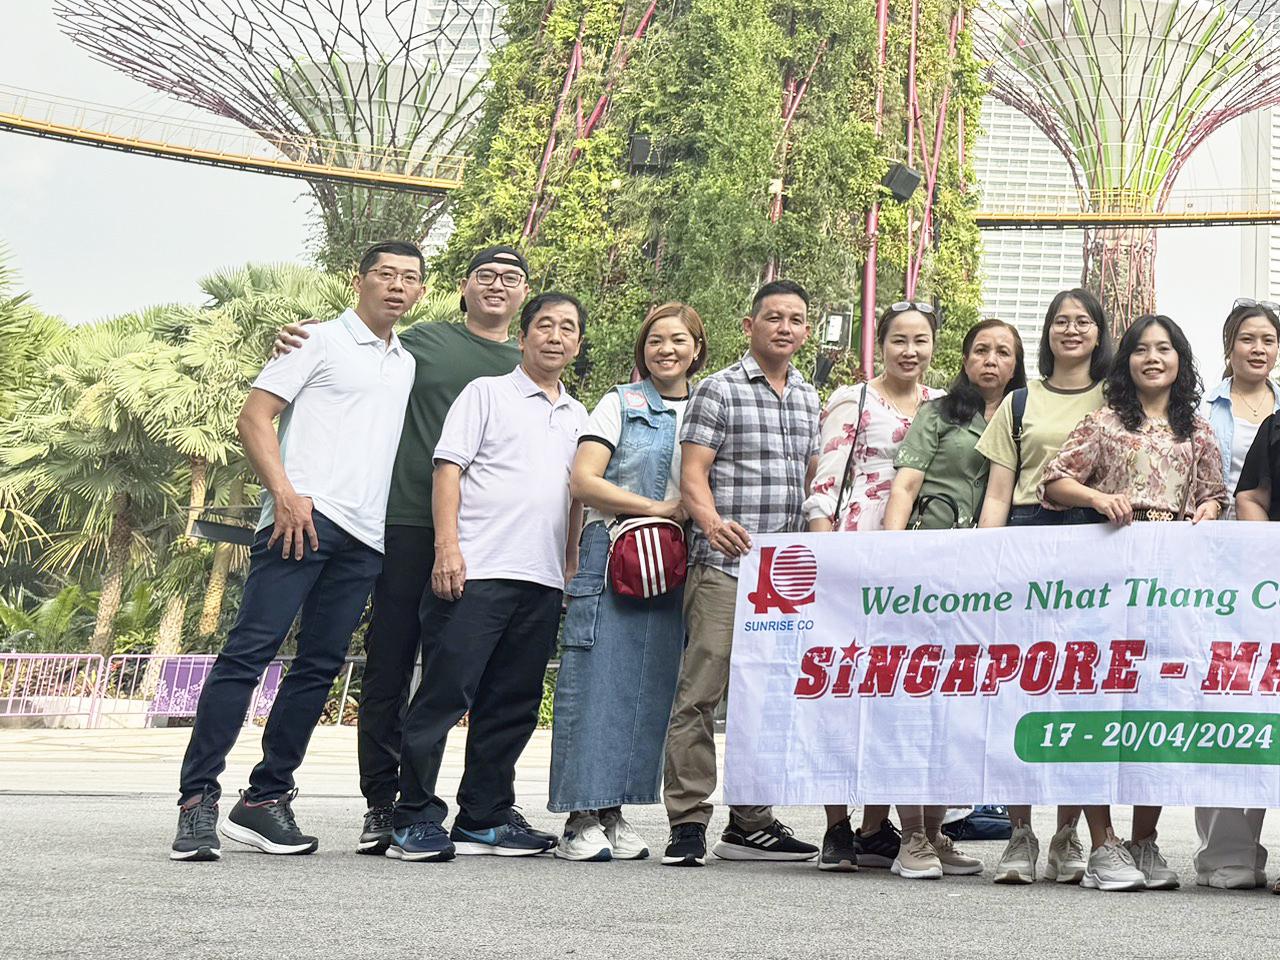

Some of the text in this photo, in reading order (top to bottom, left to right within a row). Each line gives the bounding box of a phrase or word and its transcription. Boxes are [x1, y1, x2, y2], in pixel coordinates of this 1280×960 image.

[861, 584, 1013, 616] Welcome
[1025, 579, 1112, 611] Nhat
[1124, 577, 1239, 616] Thang
[744, 619, 815, 632] SUNRISE CO
[1039, 722, 1076, 747] 17
[1101, 721, 1274, 752] 20/04/2024
